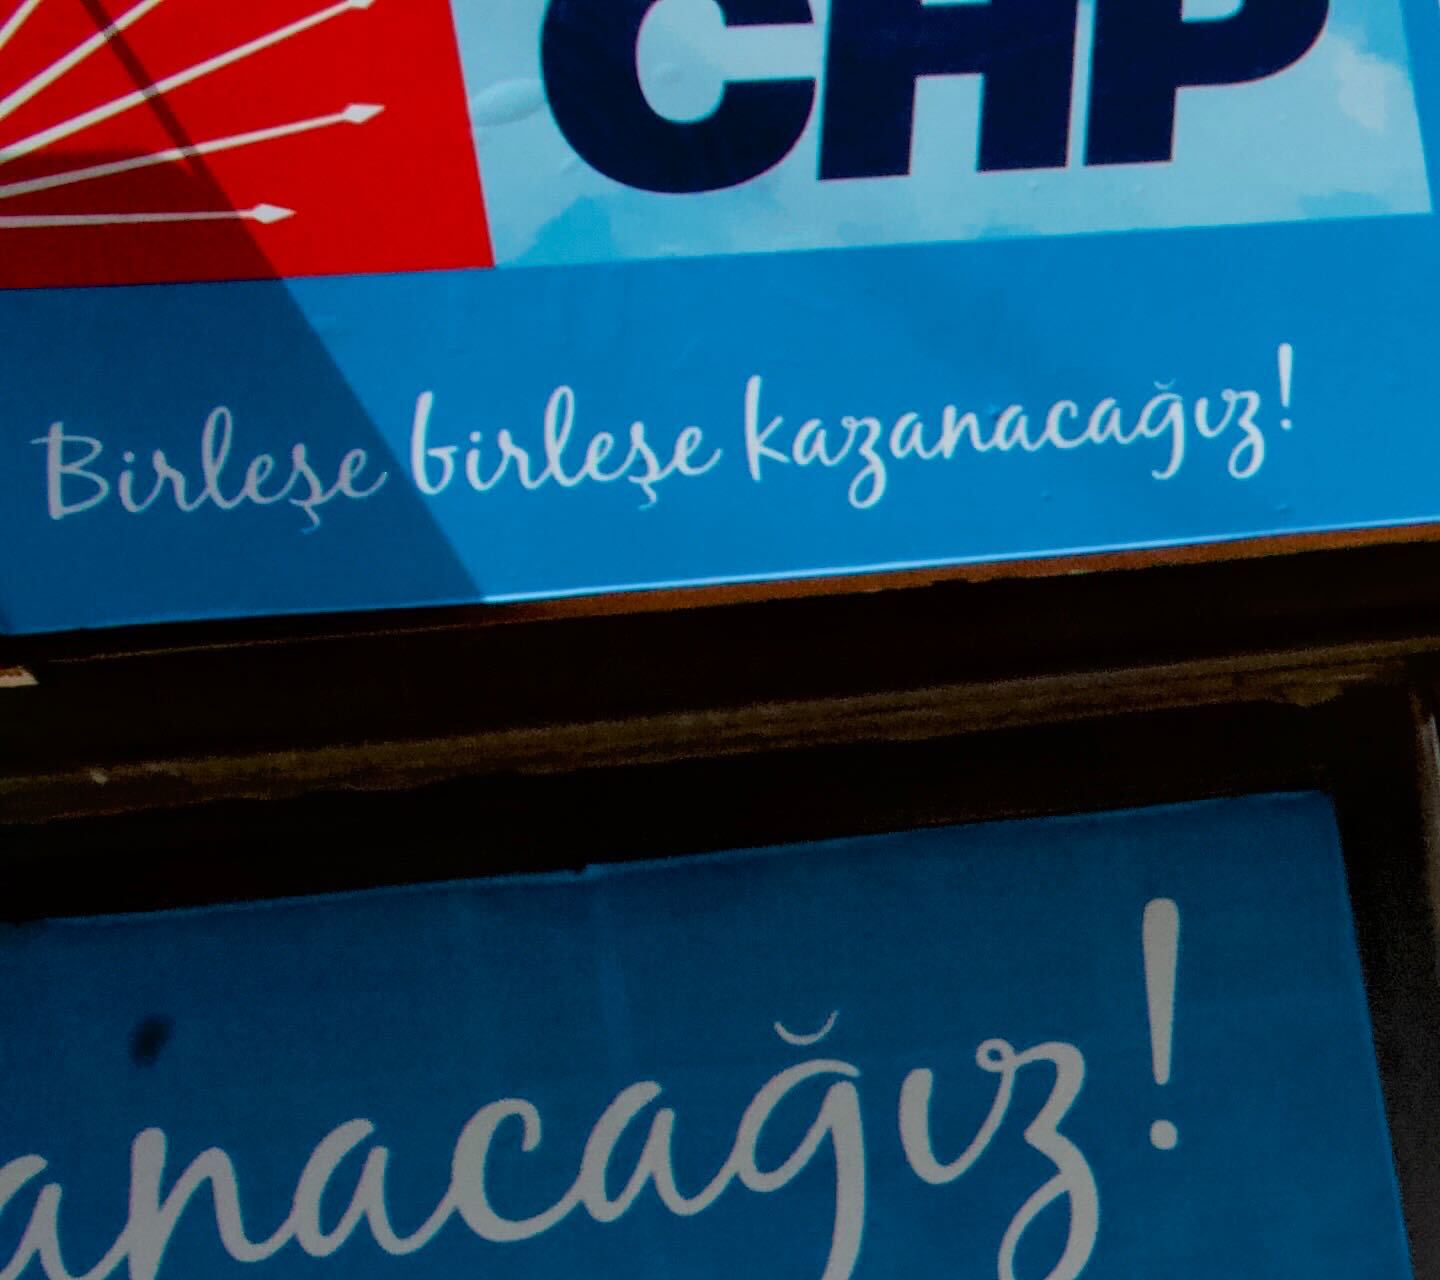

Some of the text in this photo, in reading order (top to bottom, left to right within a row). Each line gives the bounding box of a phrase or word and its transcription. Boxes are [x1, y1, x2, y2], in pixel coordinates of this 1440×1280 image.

[540, 0, 1329, 194] CHP
[31, 343, 1293, 534] Birleşe birleşe kazanacağız!
